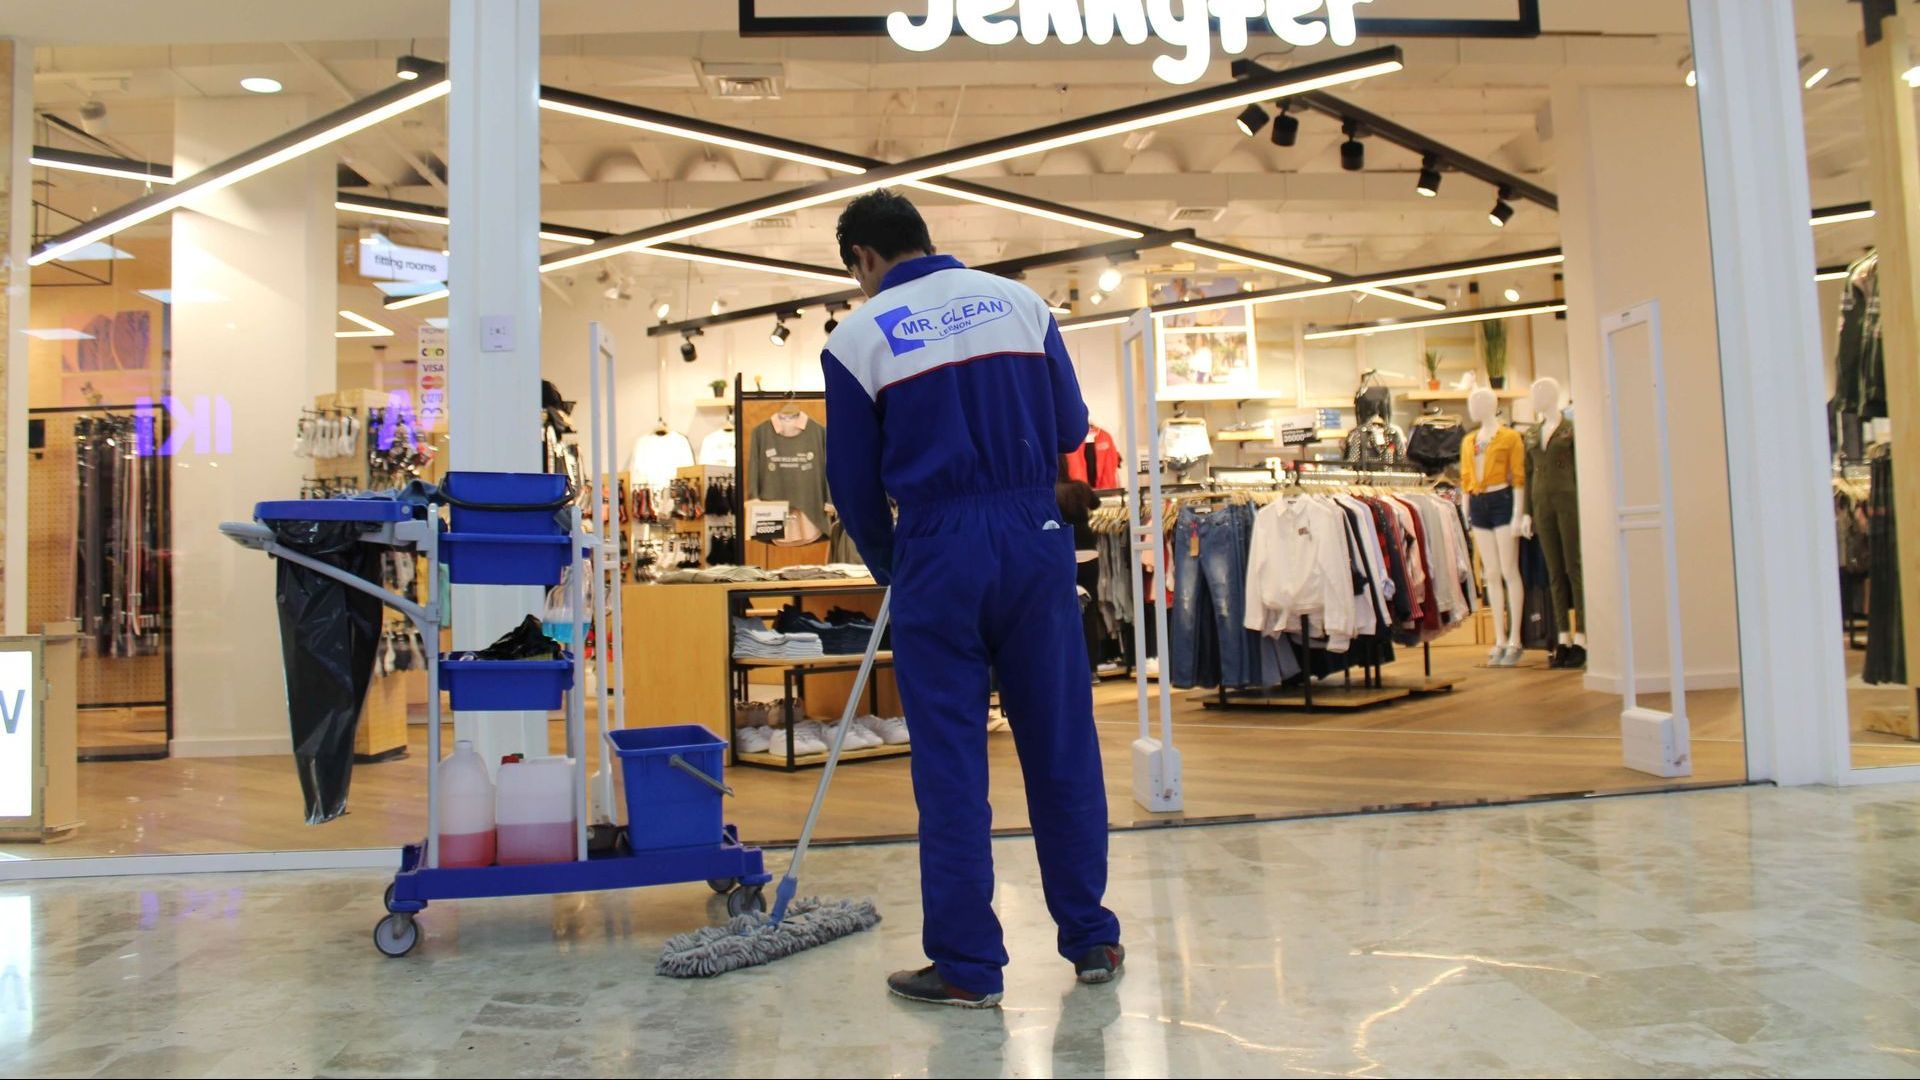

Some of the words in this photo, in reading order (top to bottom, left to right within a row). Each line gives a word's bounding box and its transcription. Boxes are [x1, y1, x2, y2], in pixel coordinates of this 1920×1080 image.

[405, 261, 437, 273] rooms
[901, 318, 938, 336] MR.
[941, 300, 1004, 326] CLEAN
[422, 364, 444, 373] VISA
